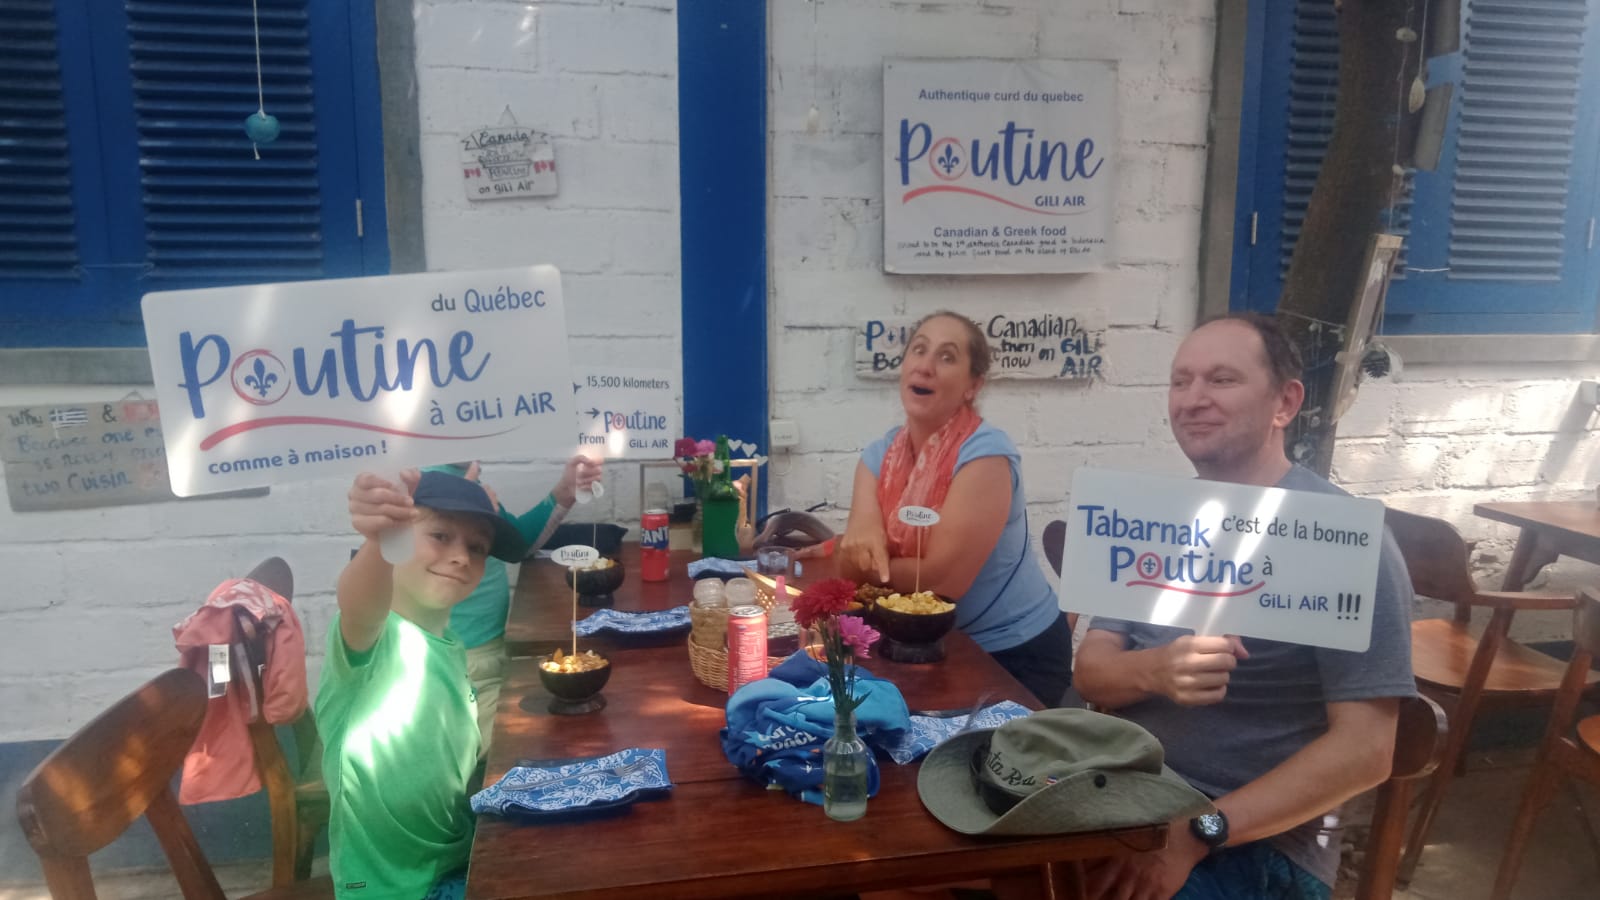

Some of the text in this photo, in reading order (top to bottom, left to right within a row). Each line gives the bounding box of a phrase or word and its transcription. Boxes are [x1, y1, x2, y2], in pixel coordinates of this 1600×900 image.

[918, 89, 1084, 104] Authentique curd du quebec
[895, 118, 1104, 186] Poutine
[479, 185, 490, 194] on
[1034, 195, 1086, 207] GILI AIR
[934, 225, 1067, 238] Canadian & Greek food
[431, 288, 546, 314] du Québec
[986, 313, 1082, 339] Canadian
[178, 318, 491, 419] Poutine
[1001, 356, 1031, 369] now
[587, 375, 670, 390] 15,500 kilometers
[430, 405, 446, 426] à
[604, 409, 667, 433] Poutine
[579, 432, 605, 445] from
[208, 454, 283, 475] comme
[288, 448, 300, 466] à
[304, 443, 377, 462] maison
[1077, 504, 1369, 548] Tabarnak c'est de la bonne
[1110, 545, 1273, 586] Poutine à
